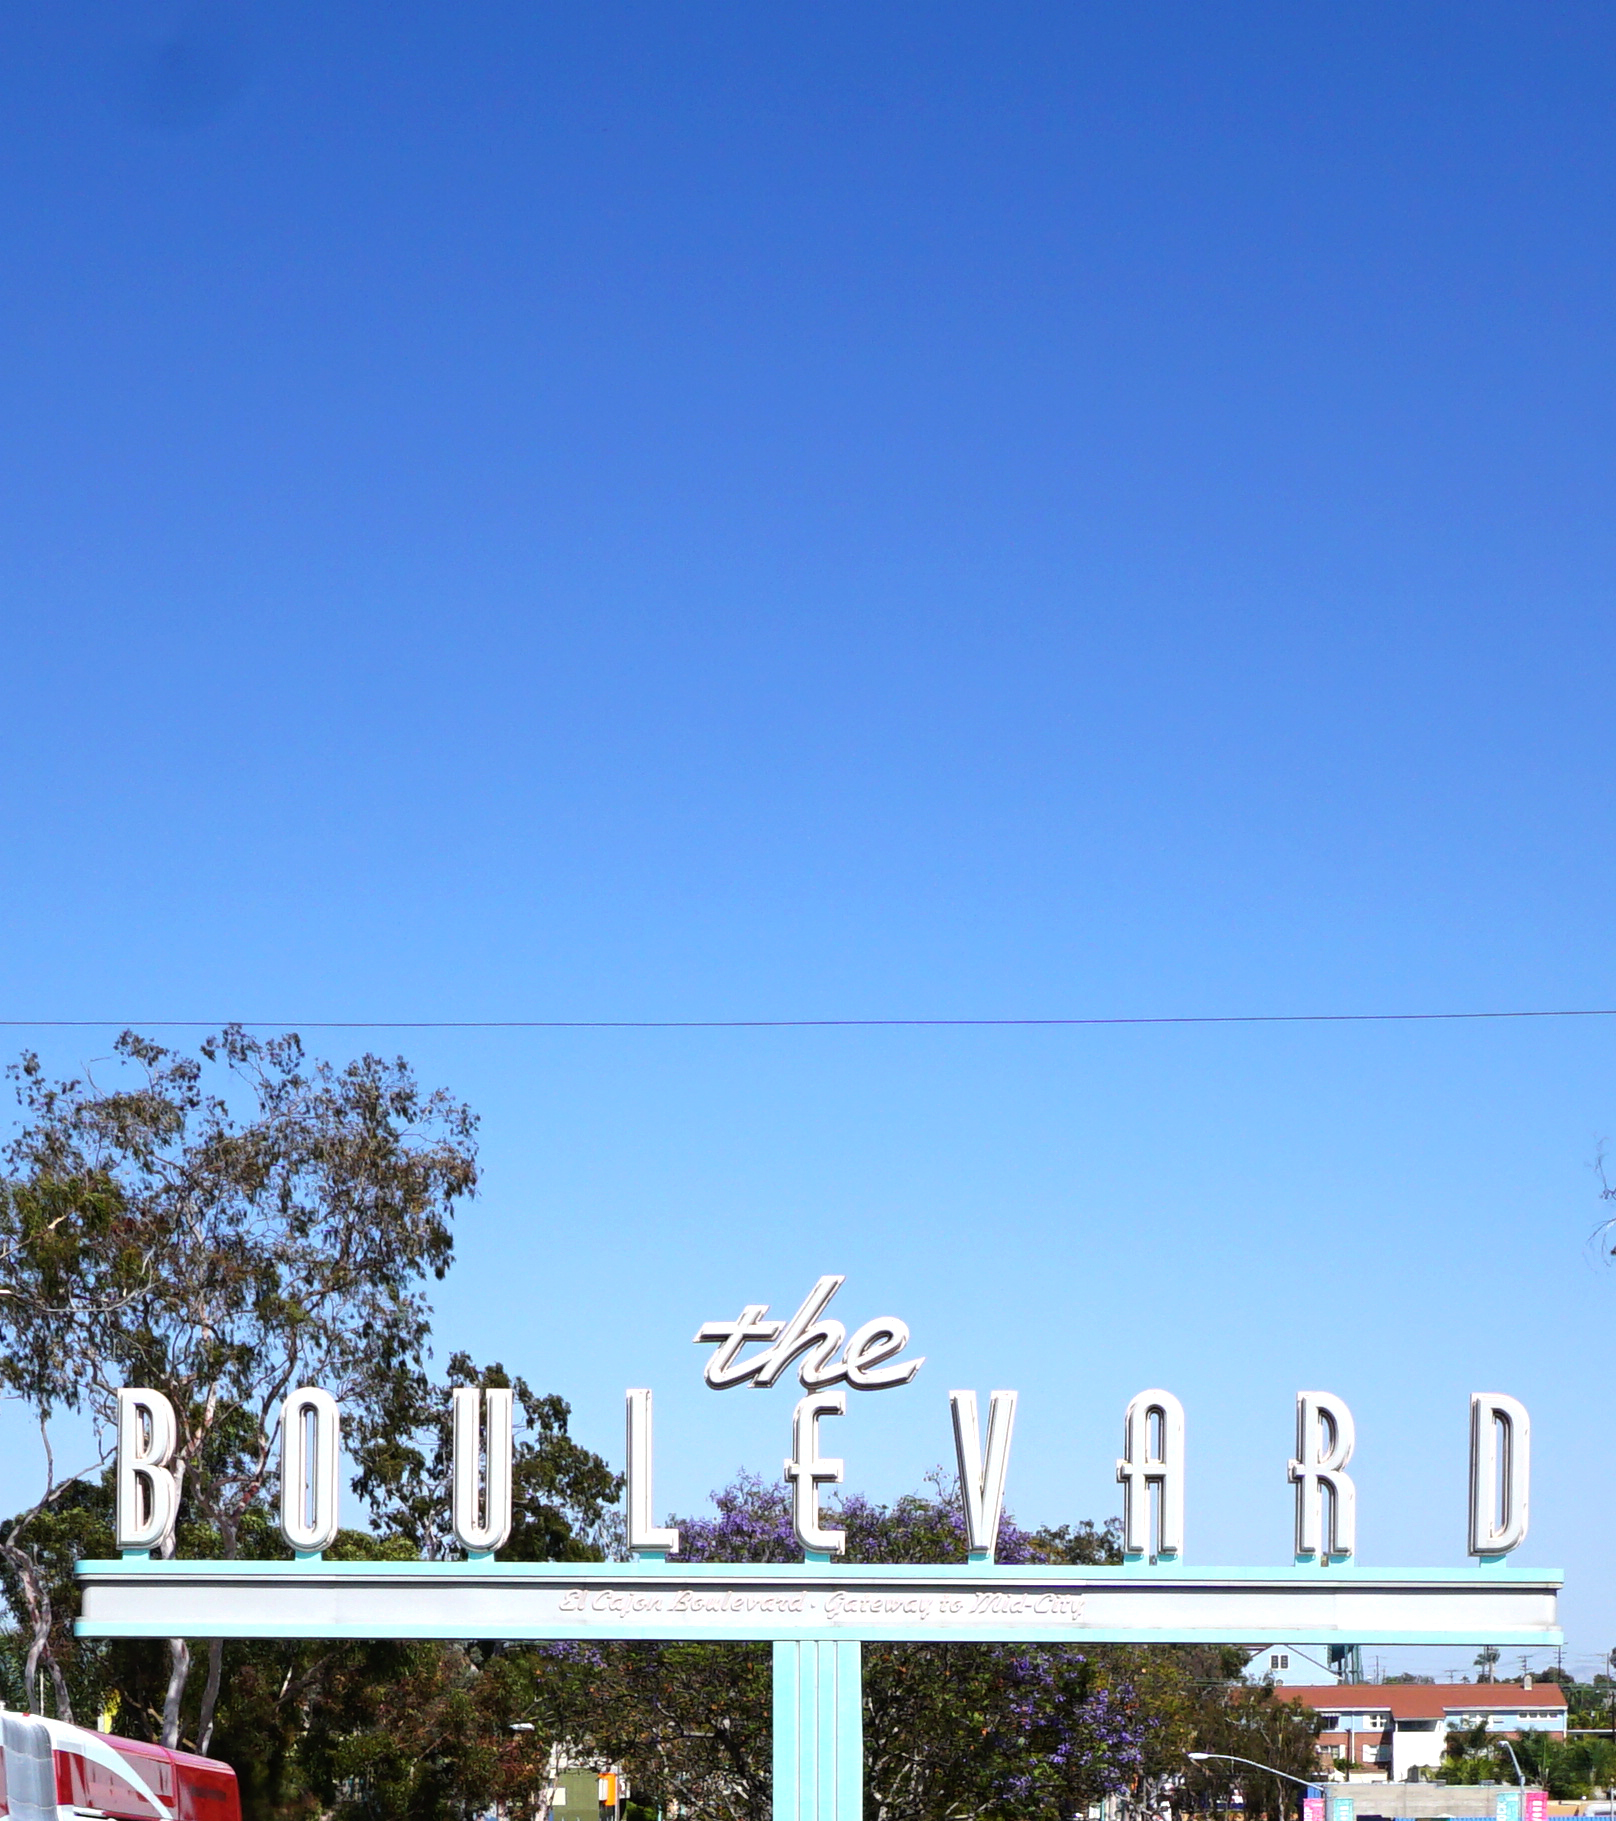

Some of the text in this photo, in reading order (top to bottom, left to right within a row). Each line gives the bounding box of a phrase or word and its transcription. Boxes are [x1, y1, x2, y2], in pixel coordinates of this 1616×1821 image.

[693, 1275, 926, 1391] the
[116, 1386, 1530, 1557] BOULEVARD
[559, 1589, 1085, 1620] El Cajon Boulevard Gateway to Mid-City
